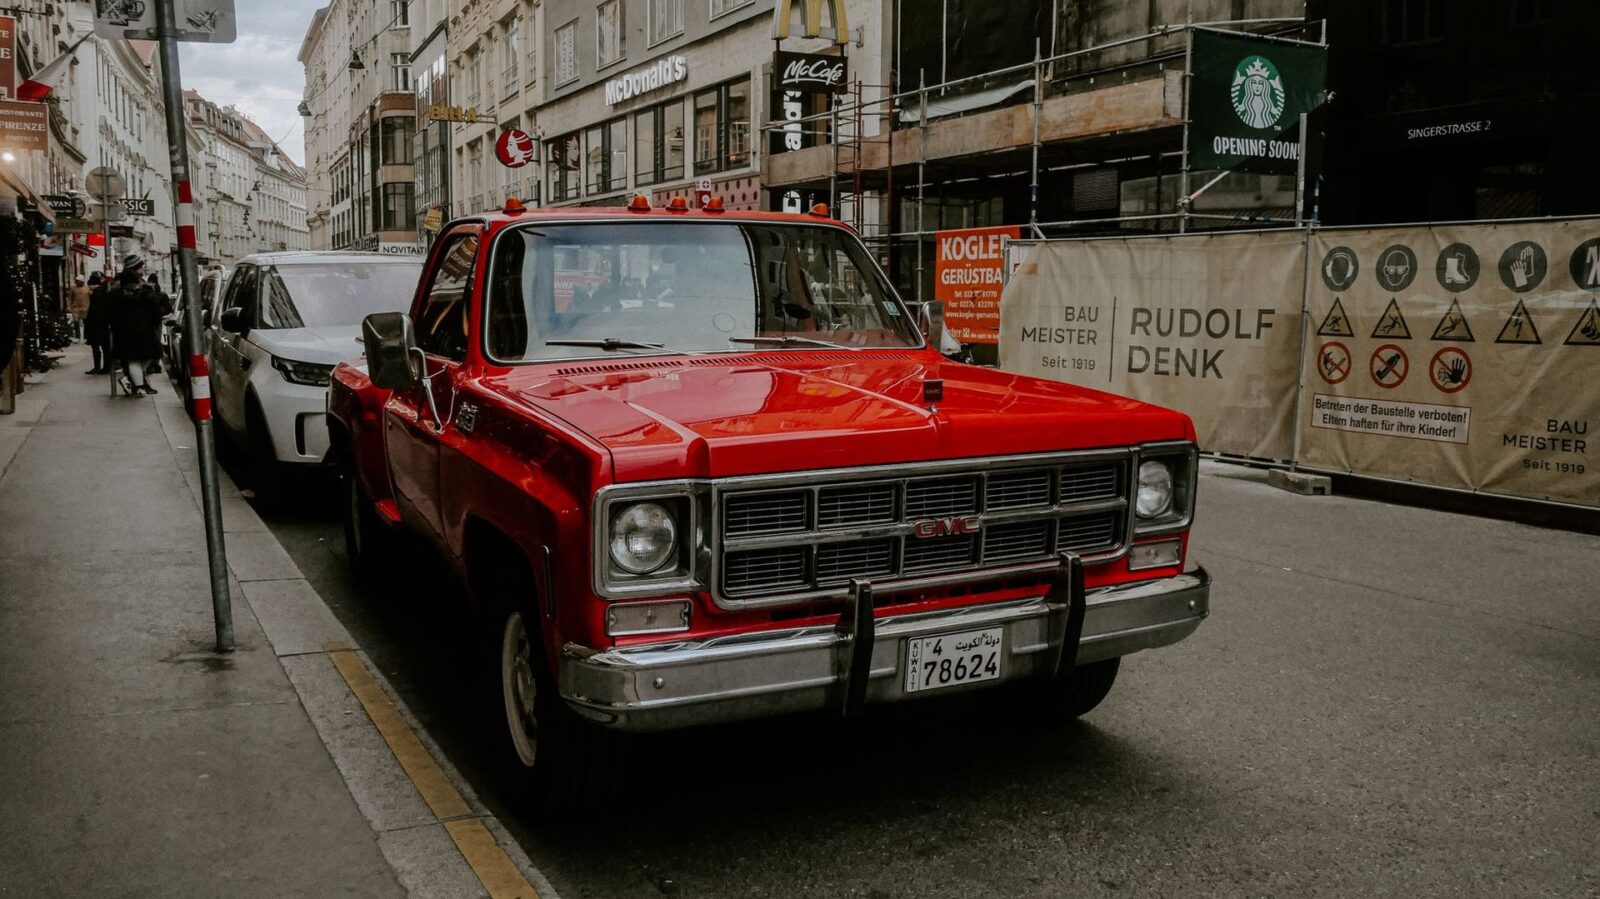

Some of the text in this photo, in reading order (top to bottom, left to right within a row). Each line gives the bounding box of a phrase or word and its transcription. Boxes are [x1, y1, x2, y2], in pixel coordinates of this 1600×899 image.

[605, 54, 688, 106] McDonald's
[783, 58, 844, 86] McCafé
[1407, 120, 1491, 139] SINGERSTRASSE 2
[1213, 135, 1300, 160] OPENING SOON!
[941, 263, 1003, 285] GERÜSTBA
[1065, 306, 1099, 323] BAU
[1130, 307, 1276, 340] RUDOLF
[1021, 326, 1098, 345] MEISTER
[1042, 356, 1096, 371] Seit 1919
[1127, 345, 1225, 379] DENK
[1315, 398, 1467, 424] Betreten der Baustelle verboten!
[1322, 413, 1456, 438] Eltern haften für ihre Kinder!
[1547, 419, 1587, 435] BAU
[1503, 433, 1587, 453] MEISTER
[1522, 459, 1585, 475] Seit 1919
[914, 514, 981, 539] GMC
[932, 638, 943, 656] 4
[955, 634, 1000, 652] دولة الكويت
[910, 641, 920, 691] KUWAIT
[923, 651, 997, 687] 78624
